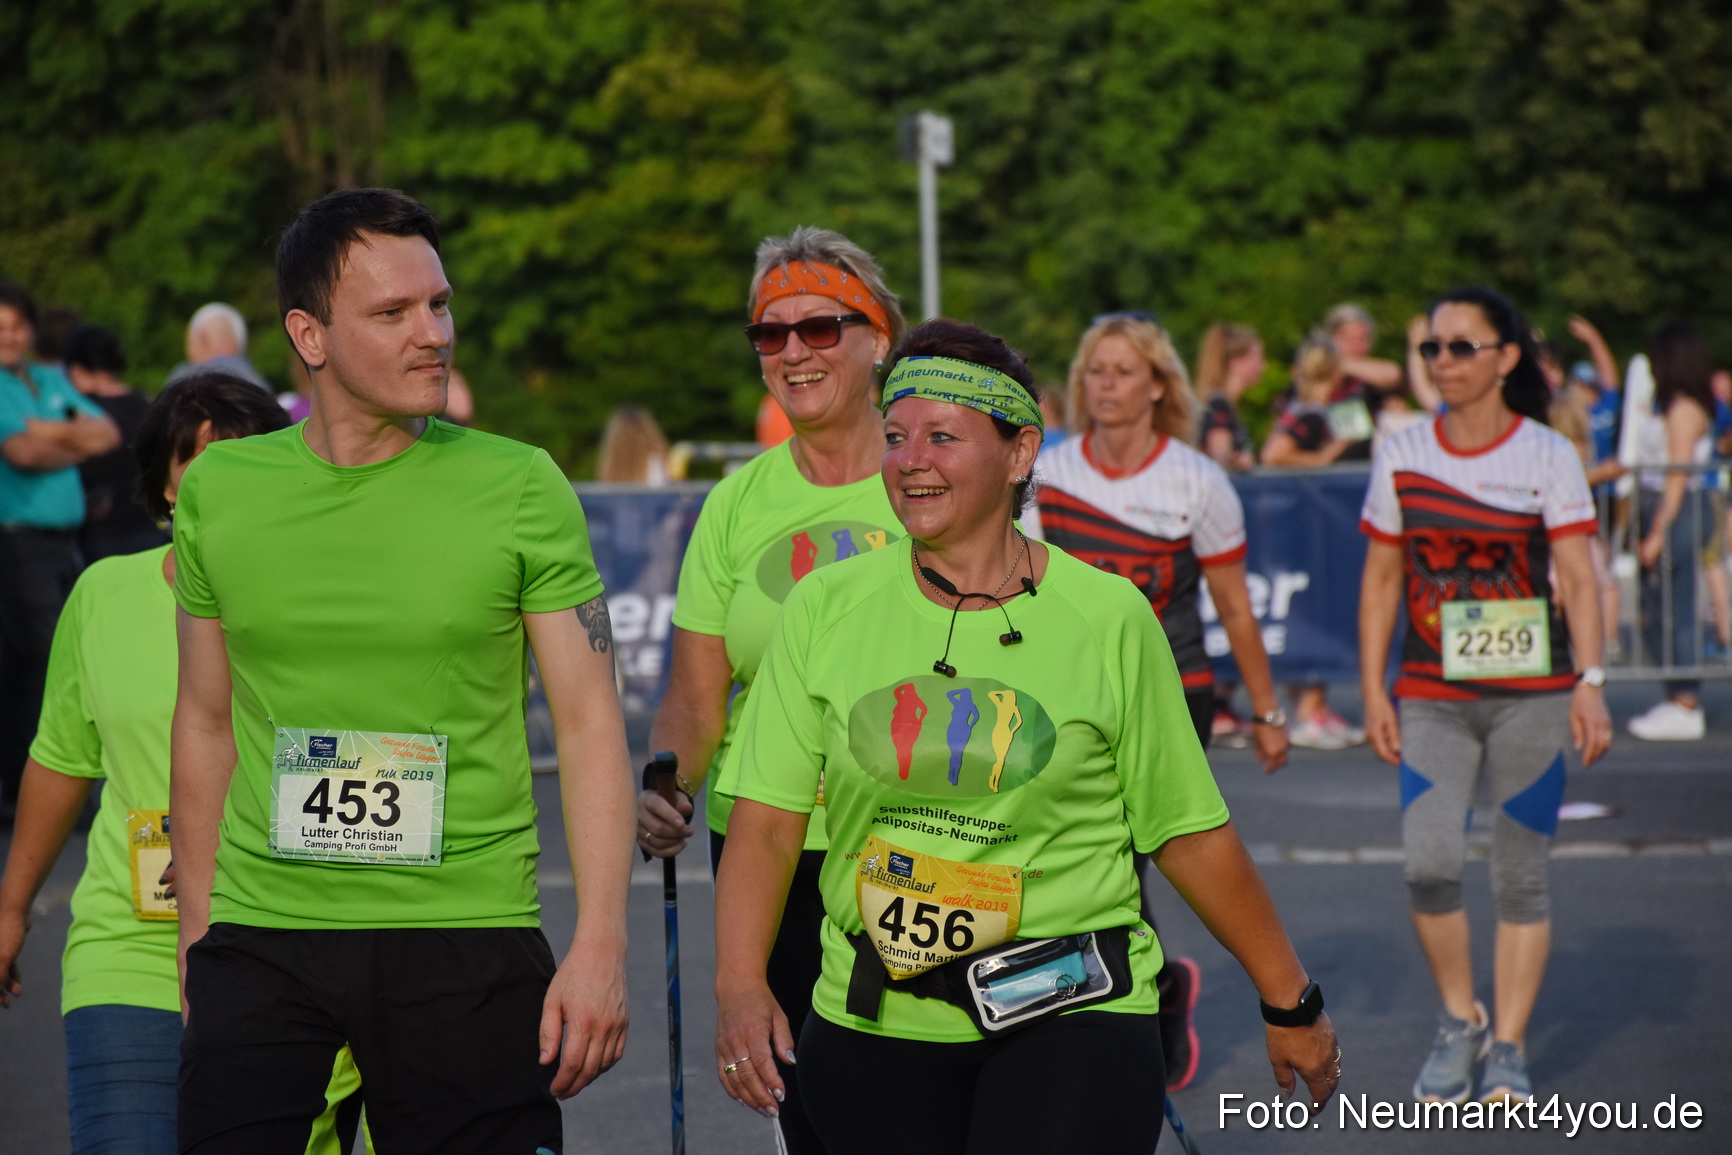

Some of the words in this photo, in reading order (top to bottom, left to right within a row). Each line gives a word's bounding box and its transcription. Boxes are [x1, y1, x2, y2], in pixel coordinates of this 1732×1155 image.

[907, 368, 974, 383] neumarkt
[1457, 628, 1533, 656] 2259
[297, 754, 362, 769] firmenlauf
[376, 769, 397, 779] run
[401, 770, 434, 781] 2019
[302, 778, 401, 827] 453
[879, 806, 1012, 832] Selbsthilfegruppe-
[301, 826, 339, 838] Lutter
[343, 828, 403, 841] Christian
[872, 815, 1019, 846] Adipositas-Neumarkt
[304, 840, 342, 851] Camping
[345, 842, 366, 850] Profi
[369, 843, 397, 852] GmbH
[876, 867, 936, 894] firmenlauf
[942, 894, 974, 909] walk
[975, 900, 1009, 912] 2019
[878, 896, 975, 952] 456
[878, 940, 920, 961] Schmid
